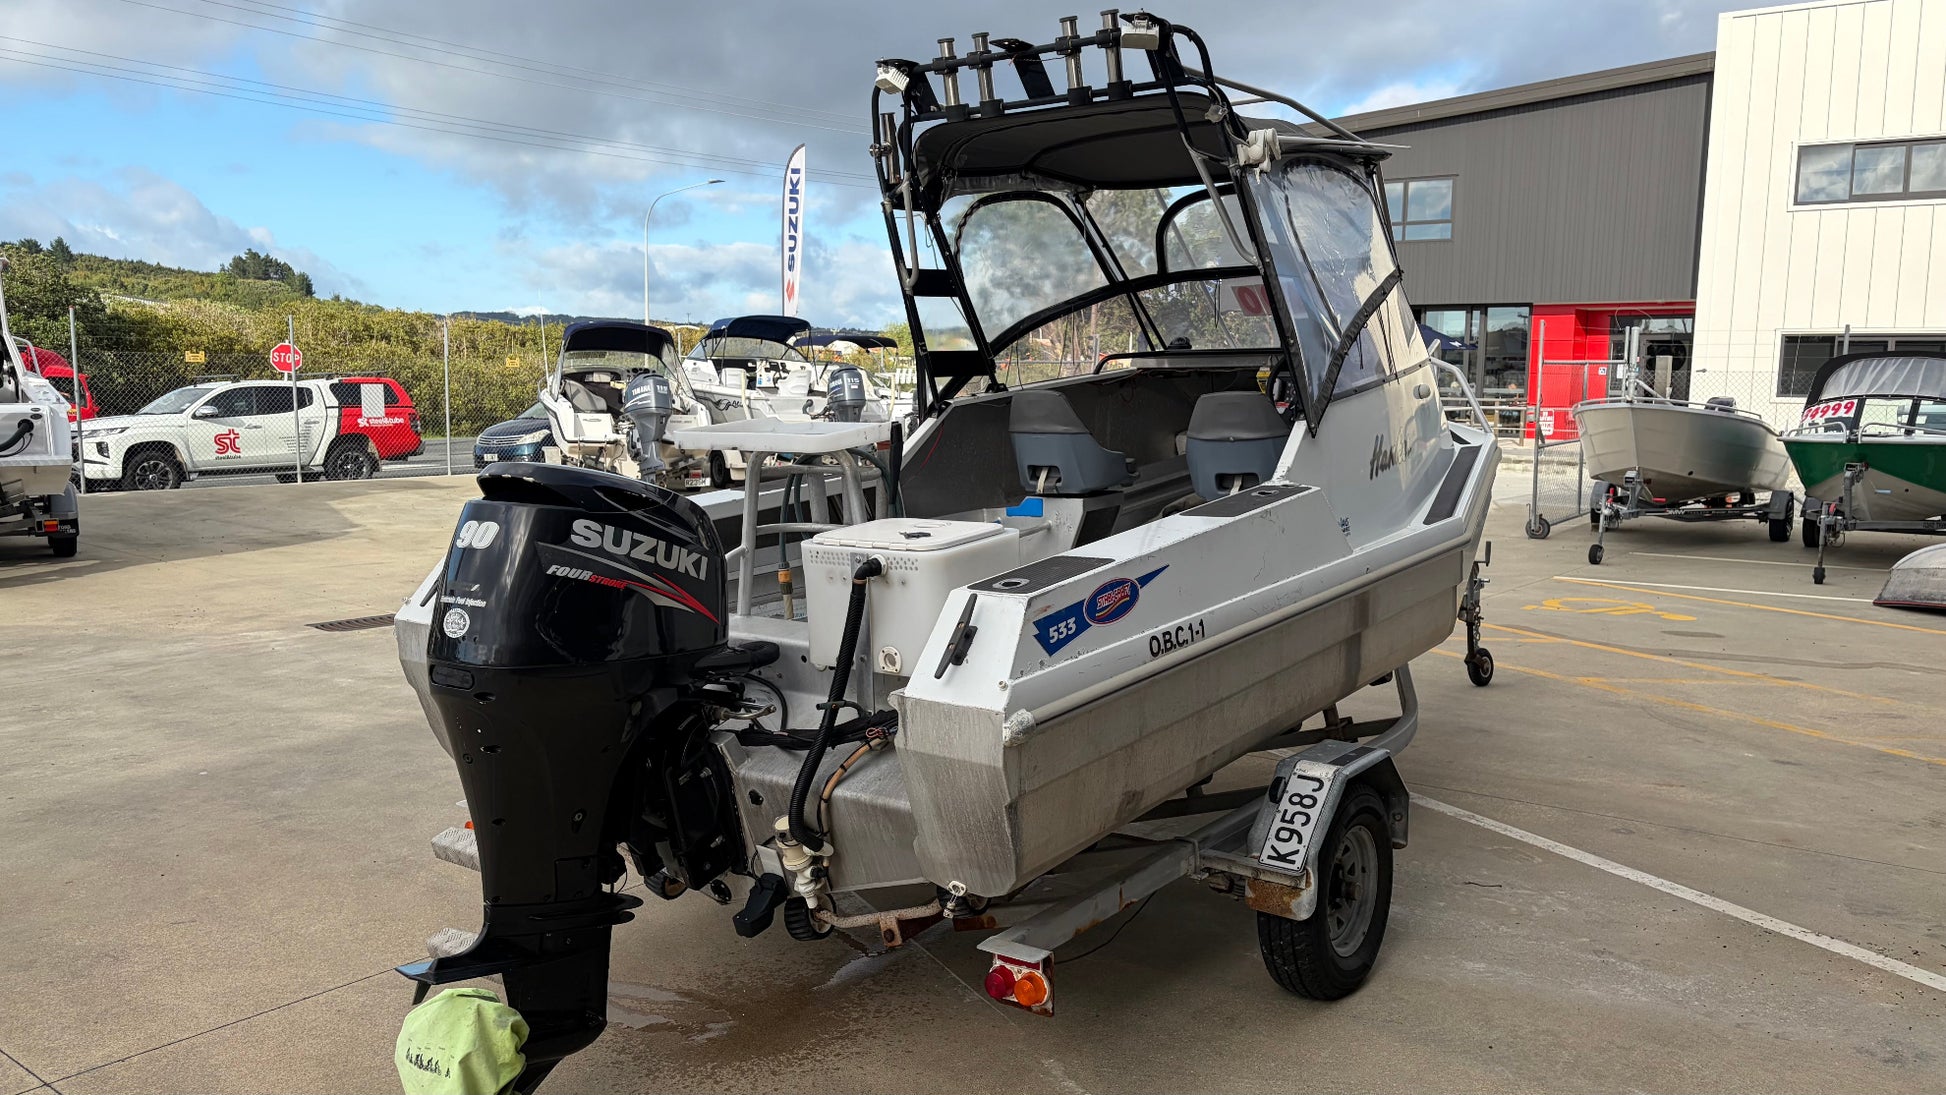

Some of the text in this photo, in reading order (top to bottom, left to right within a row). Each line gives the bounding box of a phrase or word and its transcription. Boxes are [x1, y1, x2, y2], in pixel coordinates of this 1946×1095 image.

[788, 168, 801, 272] SUZUKI
[272, 352, 300, 364] STOP
[456, 520, 500, 549] 90
[570, 519, 709, 581] SUZUKI
[1049, 617, 1077, 644] 533
[1266, 774, 1325, 865] K958J
